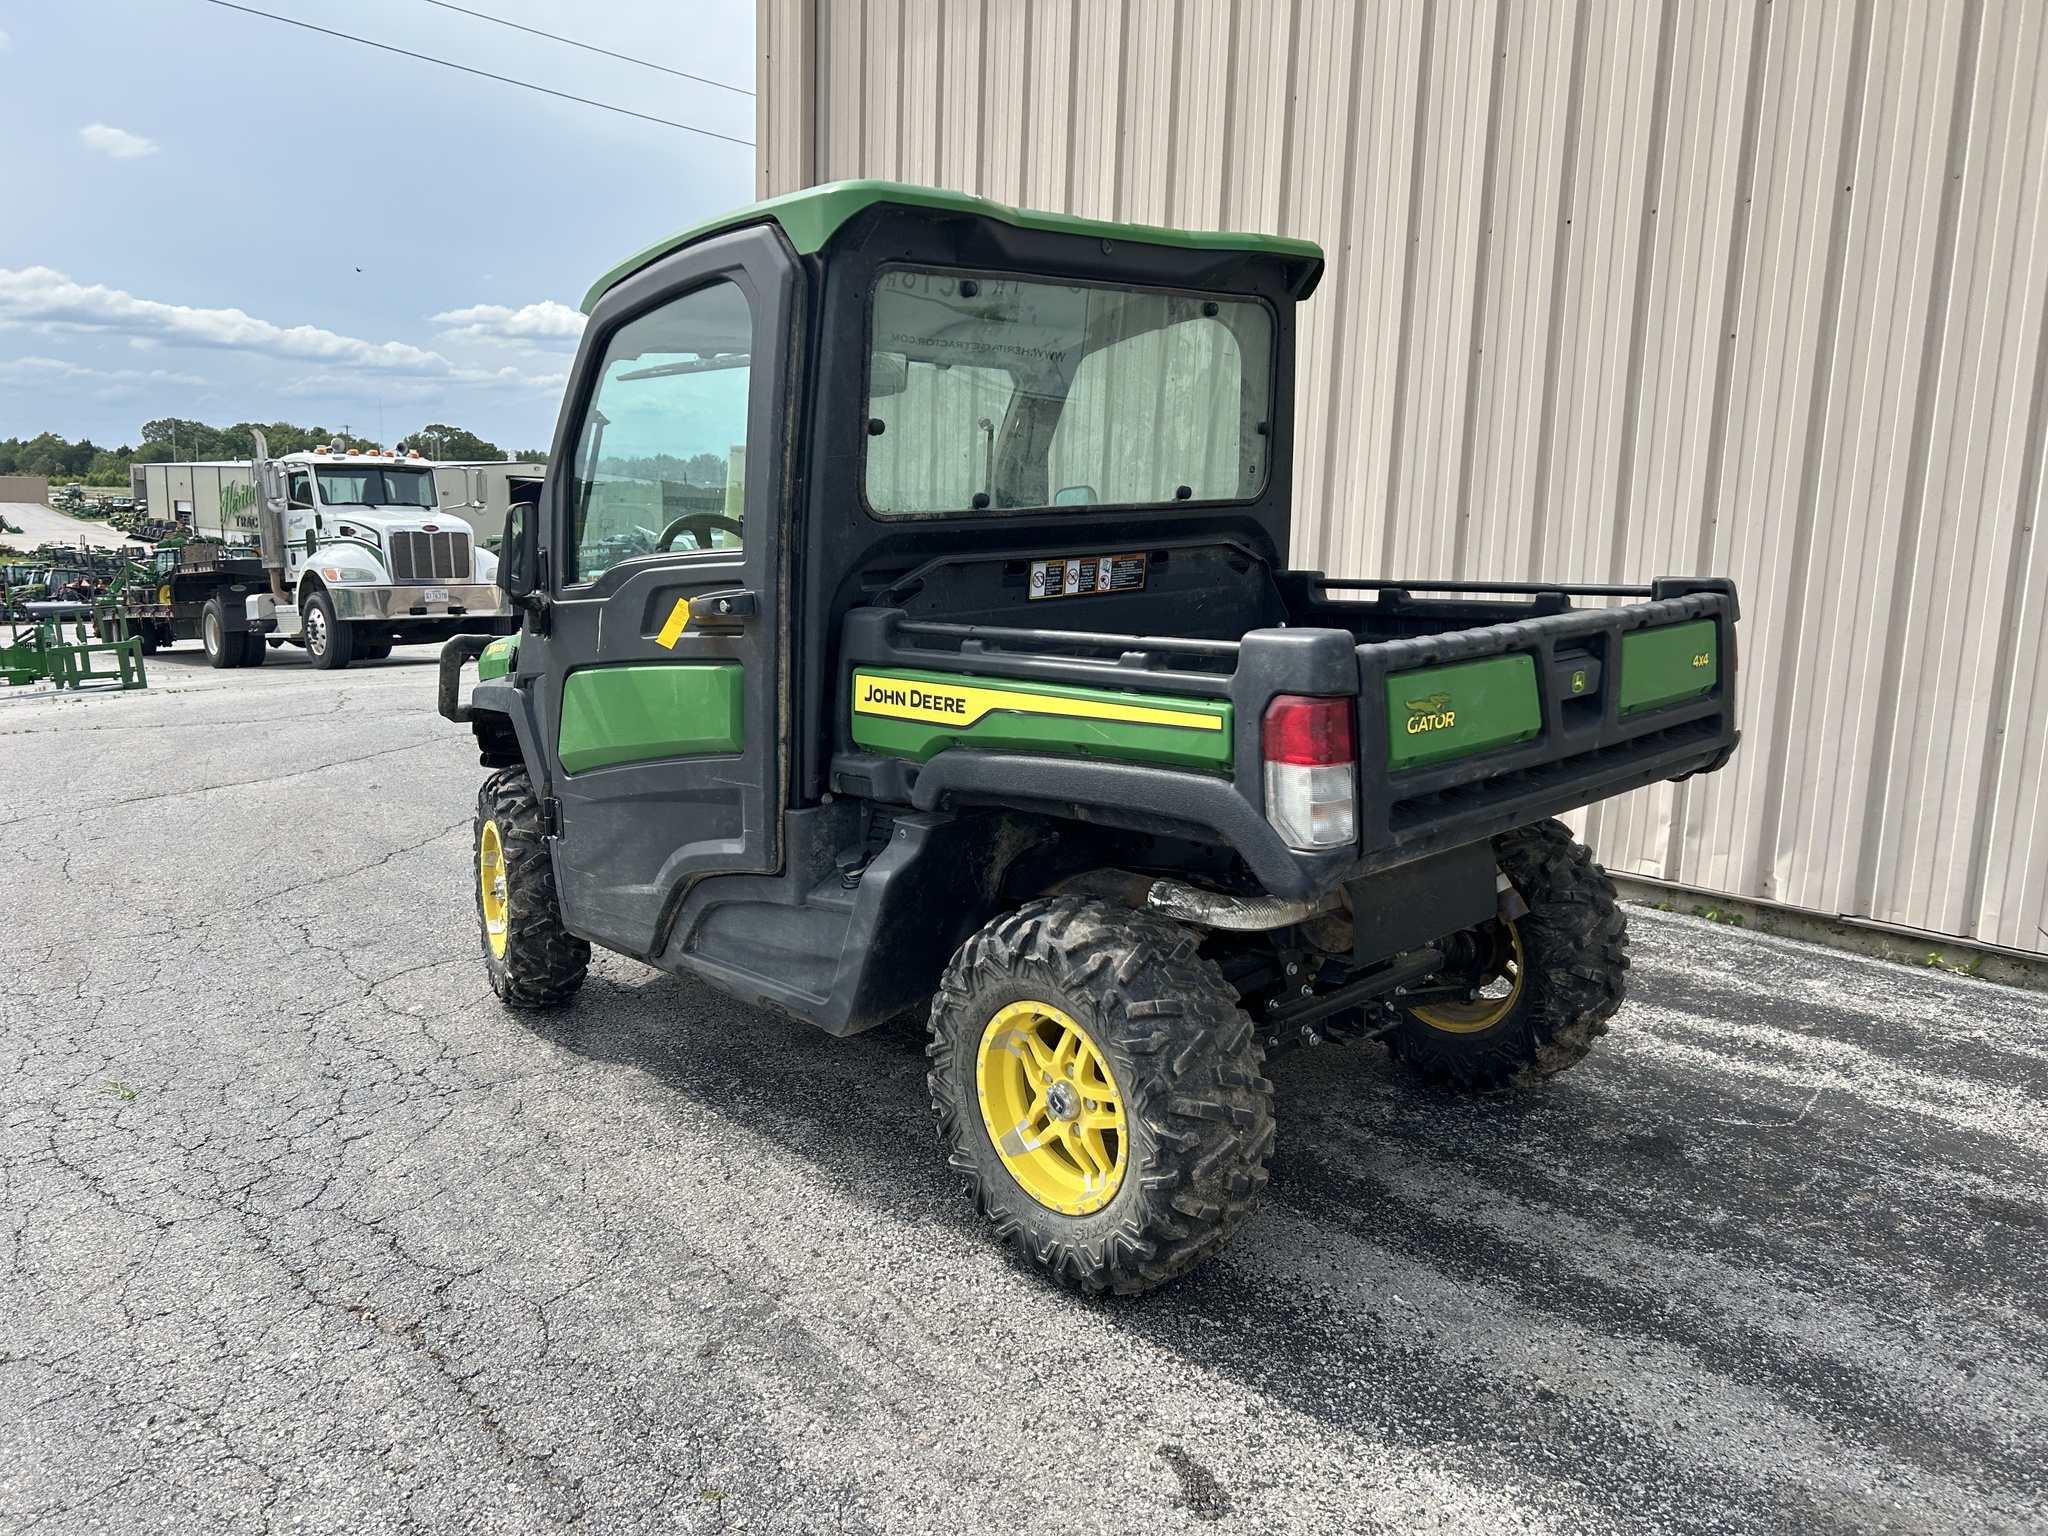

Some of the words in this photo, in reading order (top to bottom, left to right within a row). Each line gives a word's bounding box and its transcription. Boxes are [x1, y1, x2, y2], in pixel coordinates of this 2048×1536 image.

[864, 684, 906, 707] JOHN
[910, 689, 966, 714] DEERE
[1406, 711, 1456, 736] GATOR
